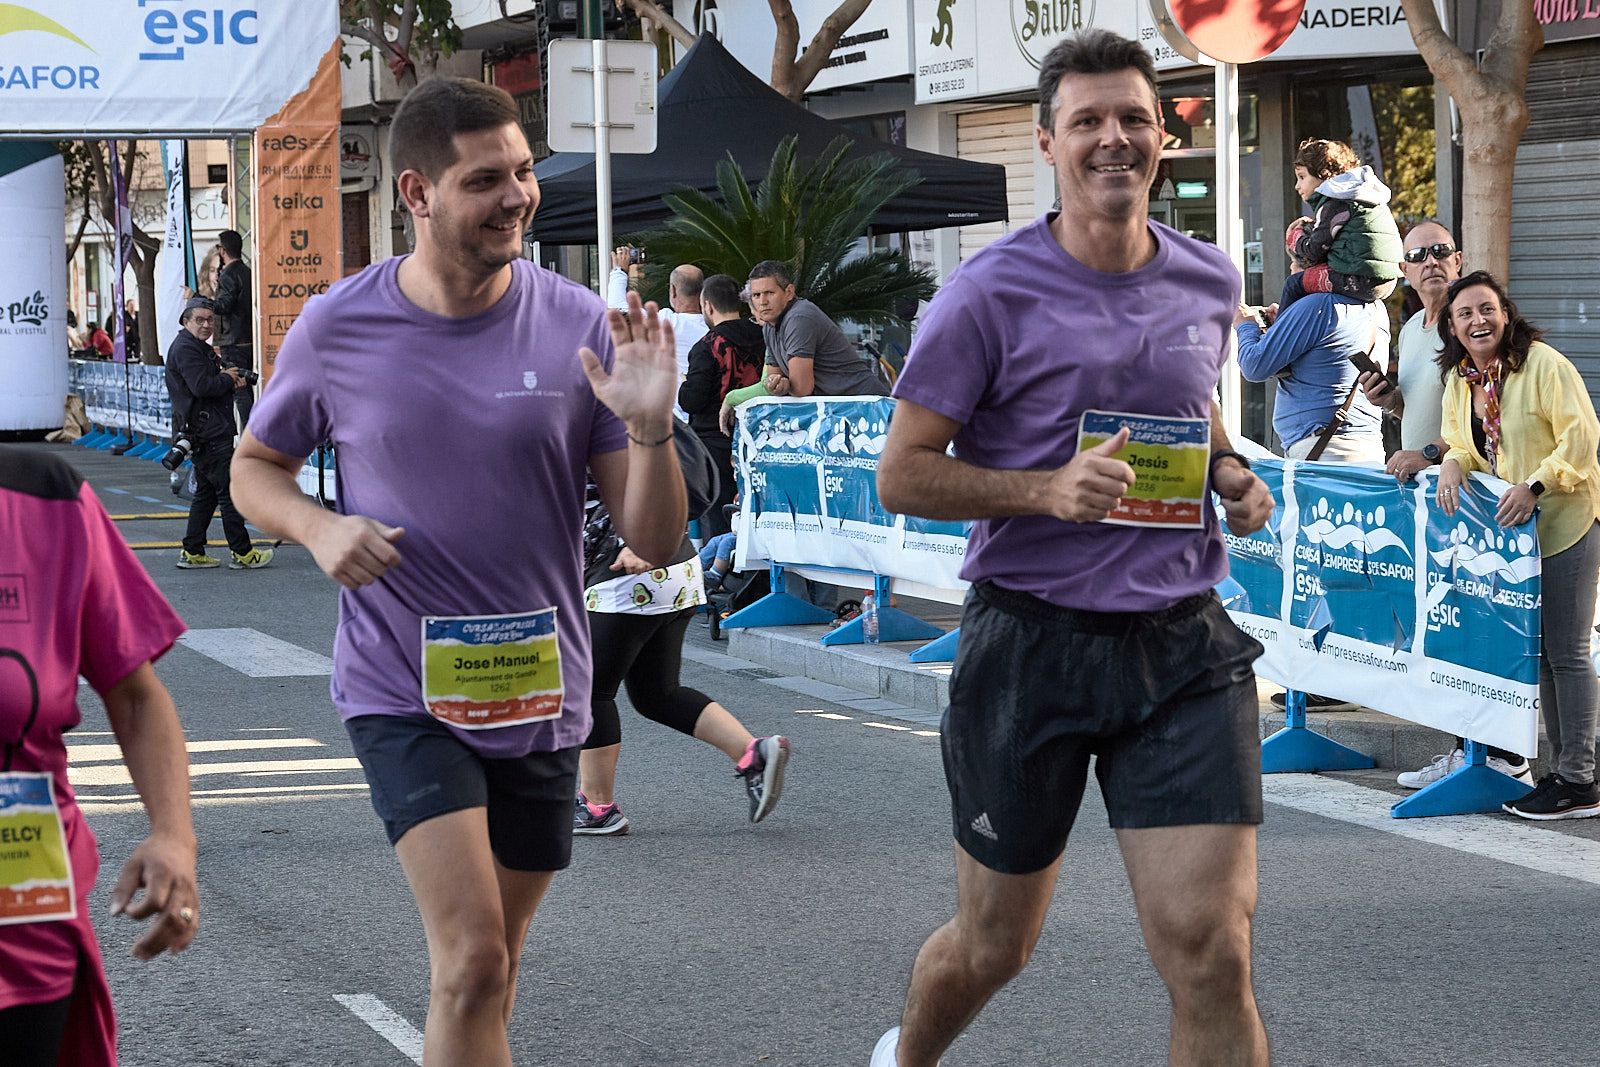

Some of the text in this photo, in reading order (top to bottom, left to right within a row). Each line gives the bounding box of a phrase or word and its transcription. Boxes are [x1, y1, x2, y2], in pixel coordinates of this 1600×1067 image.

[143, 8, 259, 46] esic
[273, 192, 324, 210] teika
[7, 296, 49, 324] plus
[1128, 454, 1169, 469] Jesús
[1380, 562, 1414, 582] SAFOR
[454, 651, 540, 670] Jose Manuel
